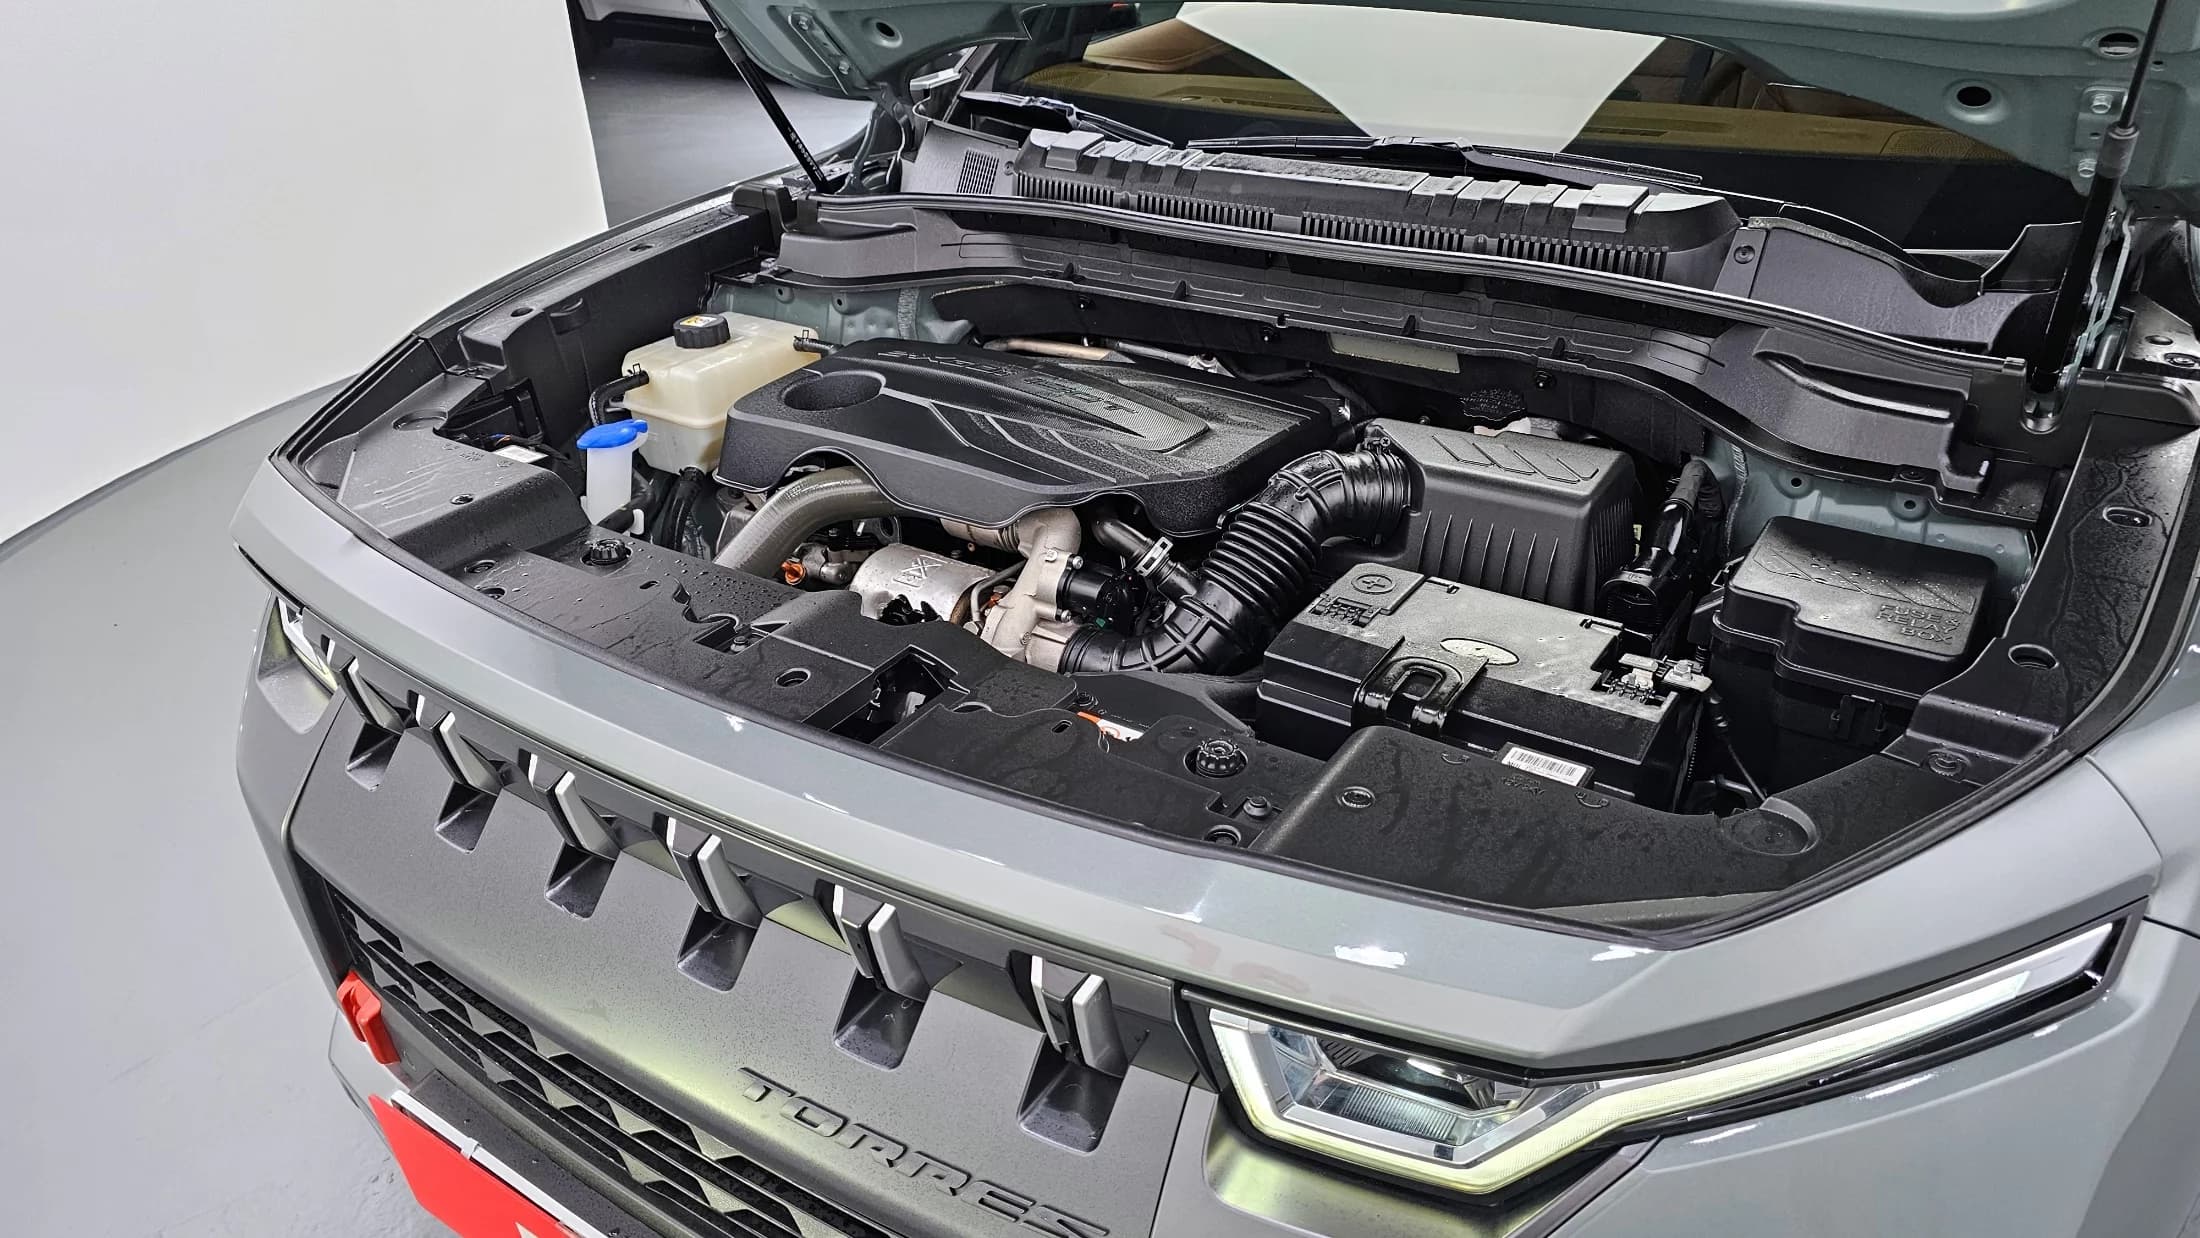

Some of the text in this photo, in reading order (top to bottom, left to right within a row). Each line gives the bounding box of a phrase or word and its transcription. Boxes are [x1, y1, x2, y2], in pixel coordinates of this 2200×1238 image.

[1876, 612, 1960, 635] RELAY
[1879, 604, 1942, 624] FUSE
[1901, 626, 1954, 645] BOX
